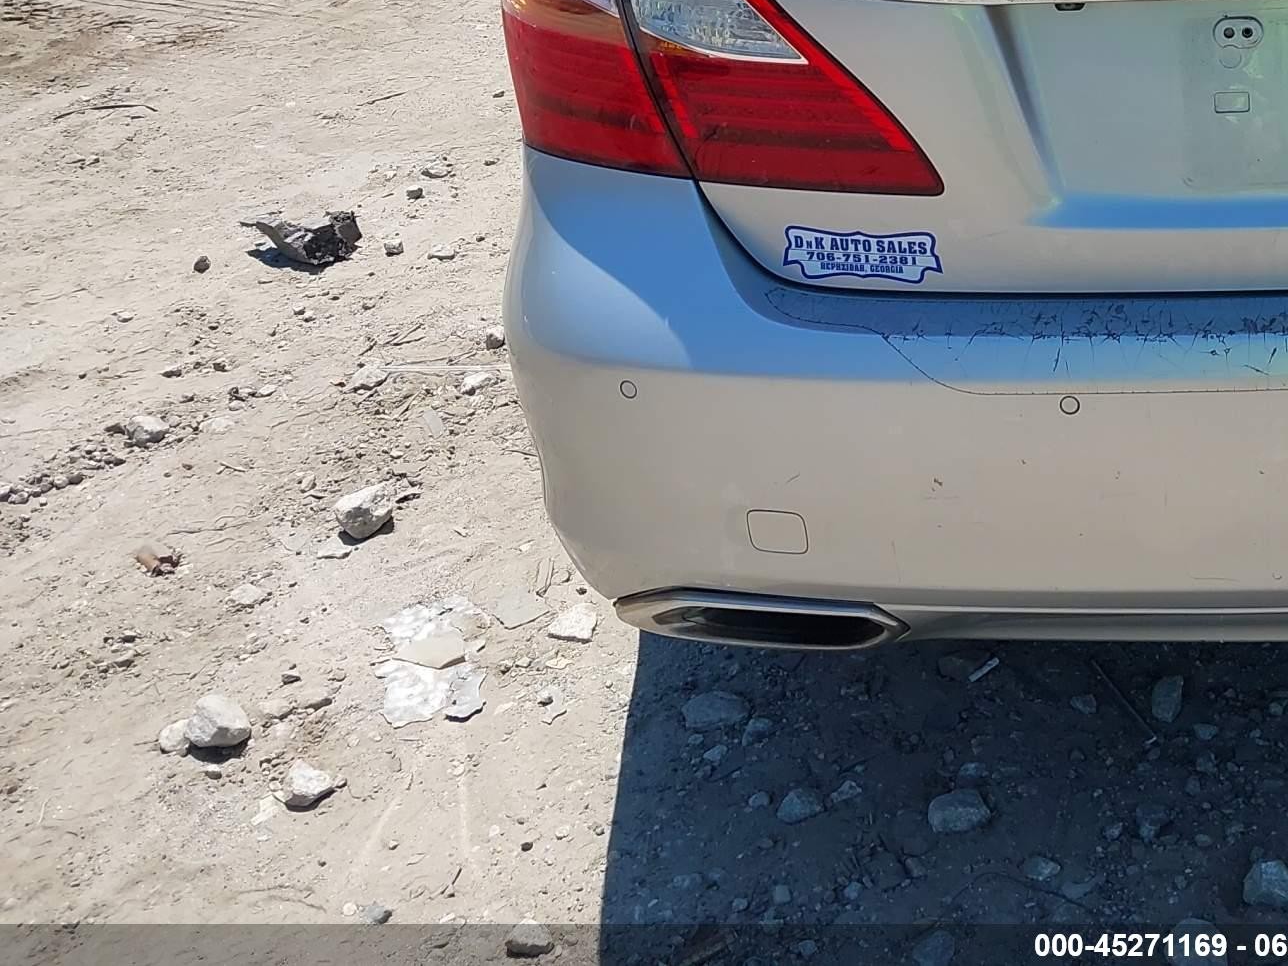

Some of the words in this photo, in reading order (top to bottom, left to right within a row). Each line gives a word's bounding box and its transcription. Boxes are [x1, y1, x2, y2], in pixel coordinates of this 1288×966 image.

[830, 237, 872, 253] AUTO
[876, 240, 928, 255] SALES
[806, 251, 917, 265] 706-751-2381
[870, 264, 904, 274] GEORGIA
